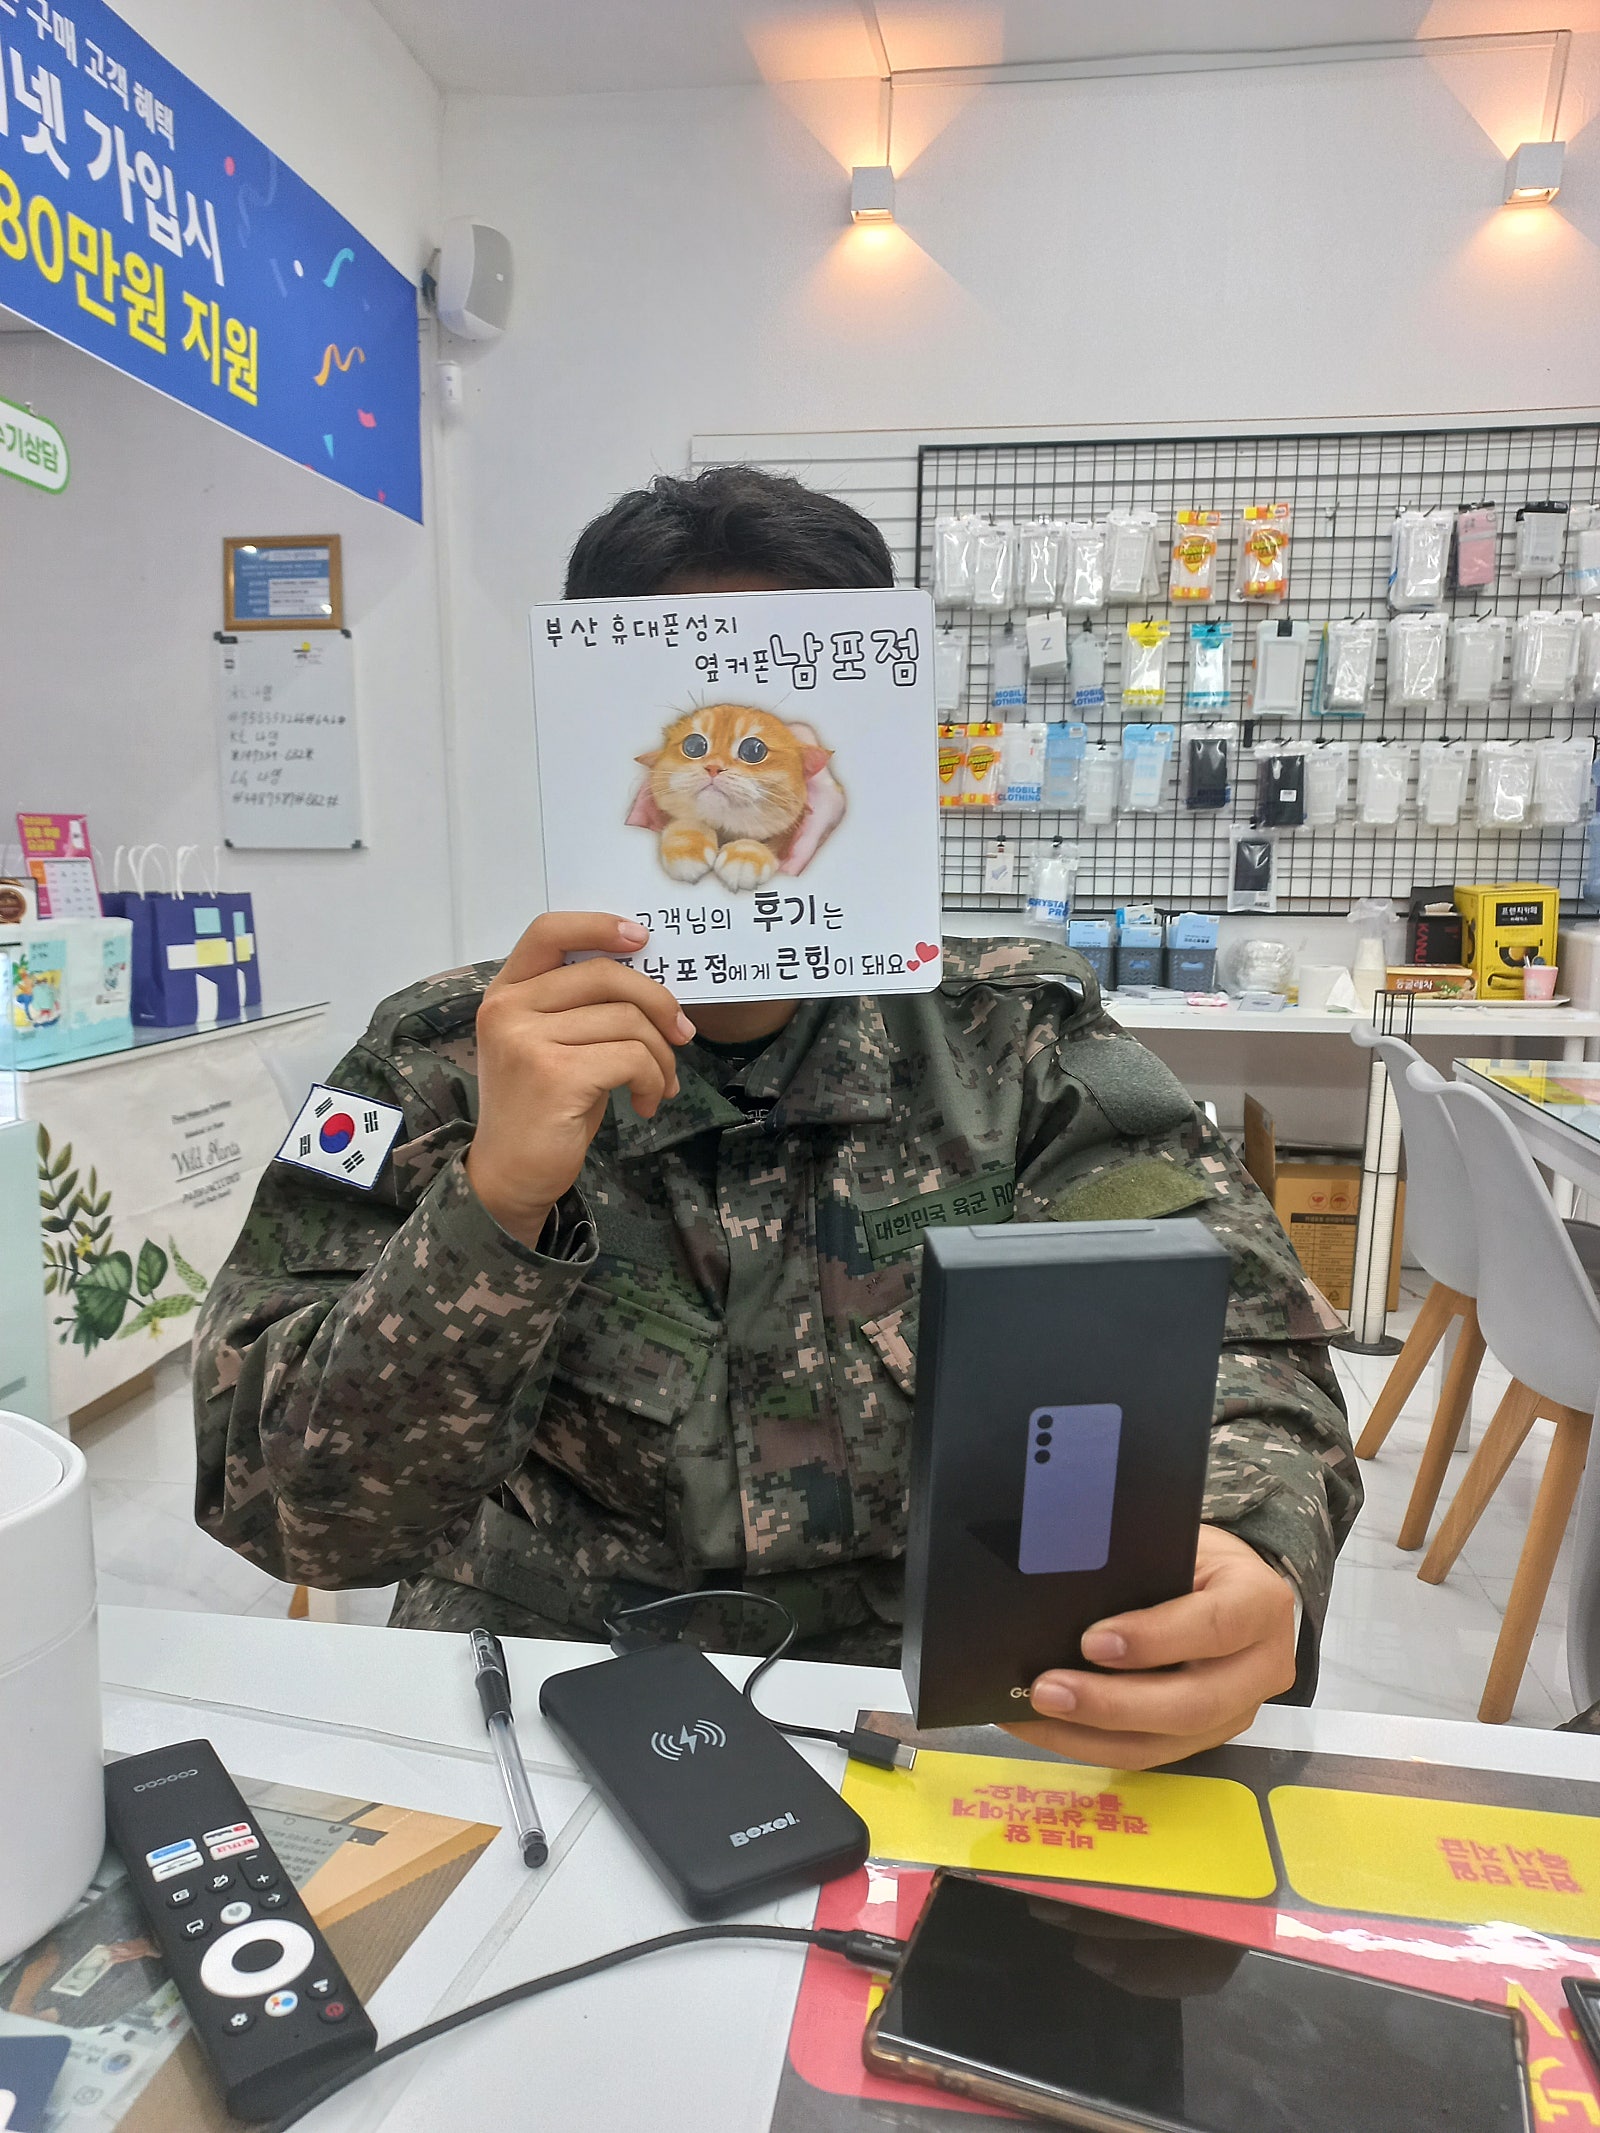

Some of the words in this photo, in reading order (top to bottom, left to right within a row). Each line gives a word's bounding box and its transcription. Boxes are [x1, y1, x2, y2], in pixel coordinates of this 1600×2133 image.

[84, 38, 130, 112] 고객
[133, 81, 175, 152] 혜택
[0, 40, 70, 181] 넷
[83, 109, 225, 287] 가입시
[182, 291, 258, 407] 지원
[546, 617, 599, 648] 부산
[611, 613, 738, 648] 휴대폰성지
[1007, 786, 1042, 794] MOBILE
[752, 891, 845, 932] 후기는
[1414, 922, 1429, 963] KANU
[874, 1203, 946, 1241] 대한민국
[952, 1190, 989, 1217] 육군
[133, 1768, 198, 1793] coocaa
[952, 1798, 1086, 1830] 상담사에게
[1094, 1813, 1149, 1836] 전문
[1037, 1828, 1094, 1850] 바로
